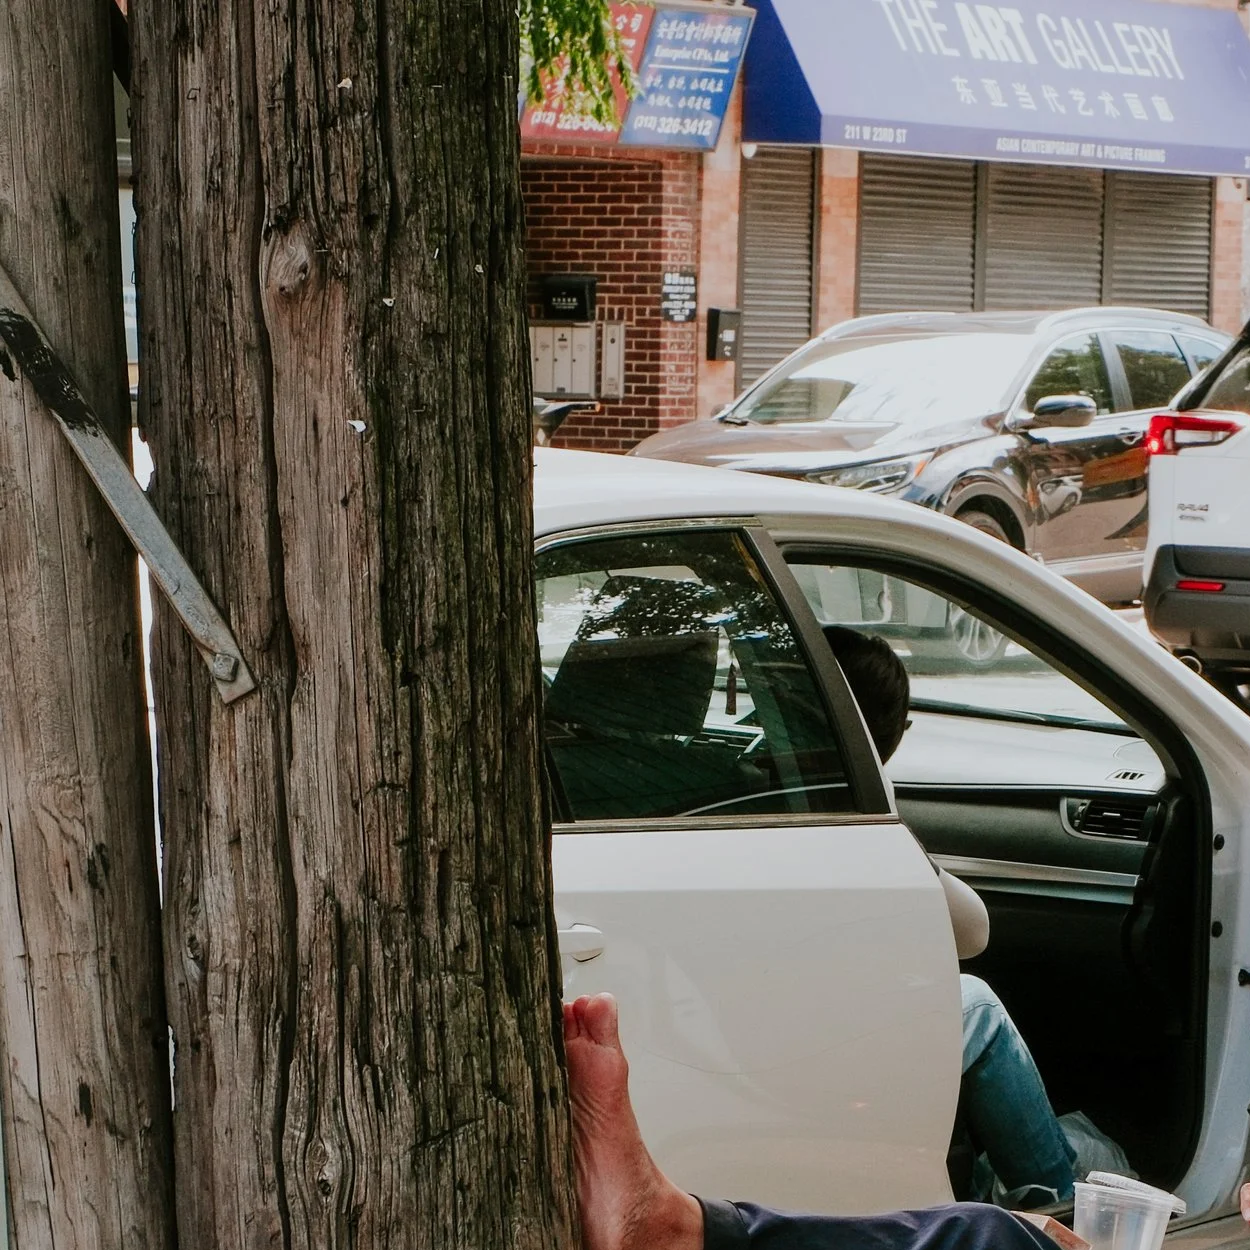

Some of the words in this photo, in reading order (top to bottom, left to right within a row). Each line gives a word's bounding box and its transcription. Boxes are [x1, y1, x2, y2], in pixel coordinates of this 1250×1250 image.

[879, 0, 960, 57] THE
[954, 2, 1039, 65] ART
[1036, 13, 1185, 80] GALLERY
[657, 116, 713, 136] 326-3412
[845, 125, 860, 139] 211
[862, 126, 871, 140] W
[872, 127, 894, 142] 23RD
[895, 129, 908, 143] ST
[996, 137, 1020, 152] ASIAN
[1021, 138, 1080, 156] CONTEMPORARY
[1080, 143, 1096, 156] ART
[1103, 145, 1133, 160] PICTURE
